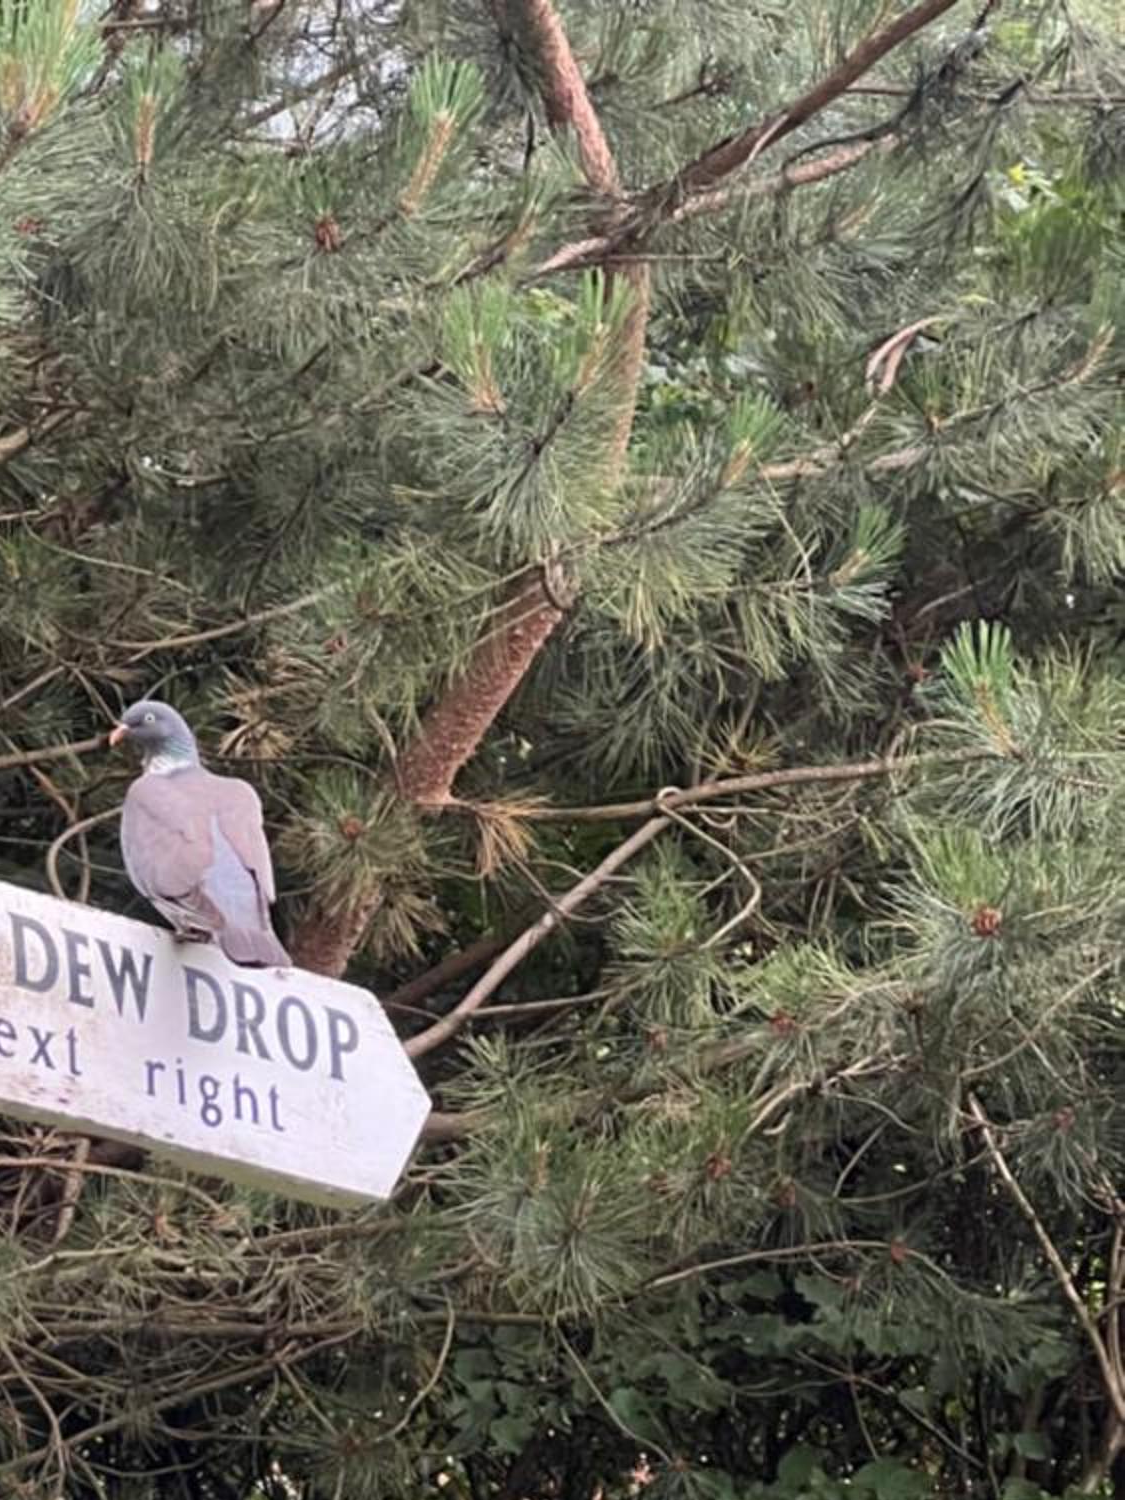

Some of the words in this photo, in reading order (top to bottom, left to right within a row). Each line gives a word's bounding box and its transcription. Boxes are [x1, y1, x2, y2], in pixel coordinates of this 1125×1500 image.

[8, 911, 153, 1022] DEW
[183, 965, 359, 1081] DROP
[146, 1058, 284, 1132] right
